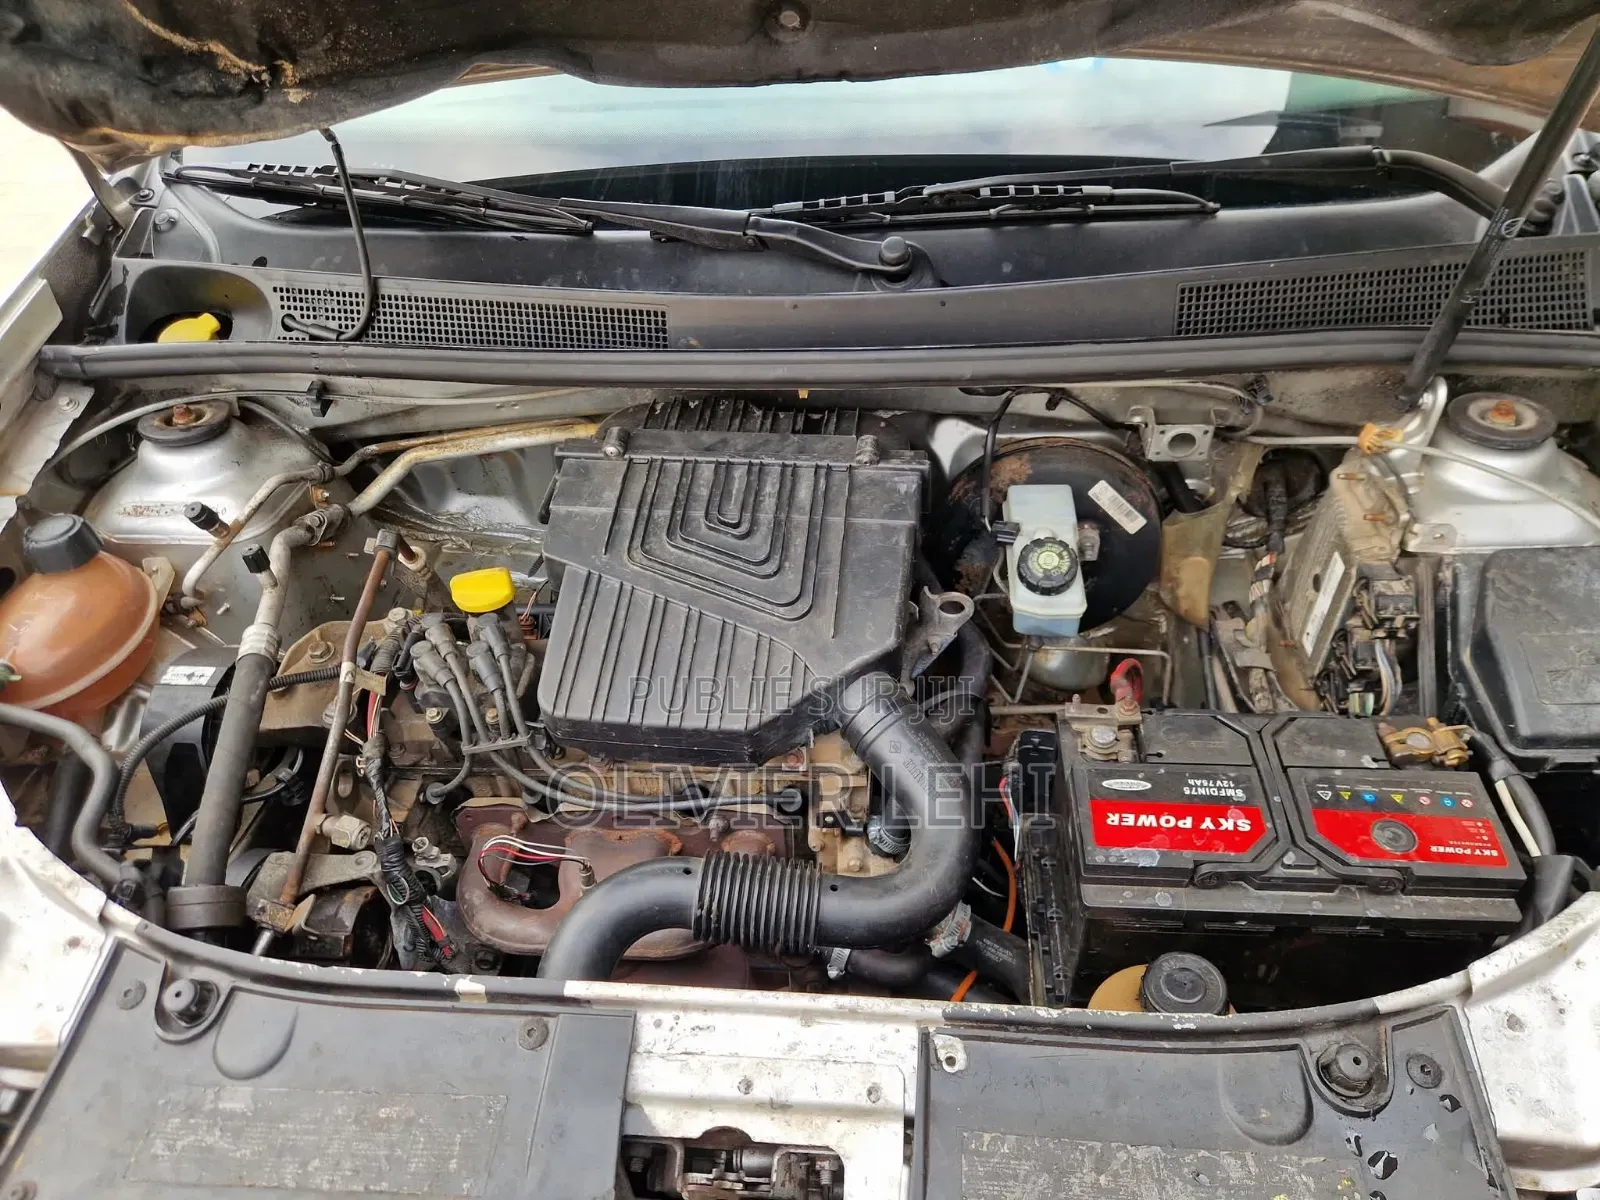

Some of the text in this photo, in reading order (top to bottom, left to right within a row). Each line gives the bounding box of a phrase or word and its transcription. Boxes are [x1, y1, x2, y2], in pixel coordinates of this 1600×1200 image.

[1188, 778, 1235, 788] 12V 75Ah
[1183, 786, 1244, 798] SMFDIN75
[1106, 812, 1252, 832] SKY POWER
[1430, 845, 1499, 857] SKY POWER
